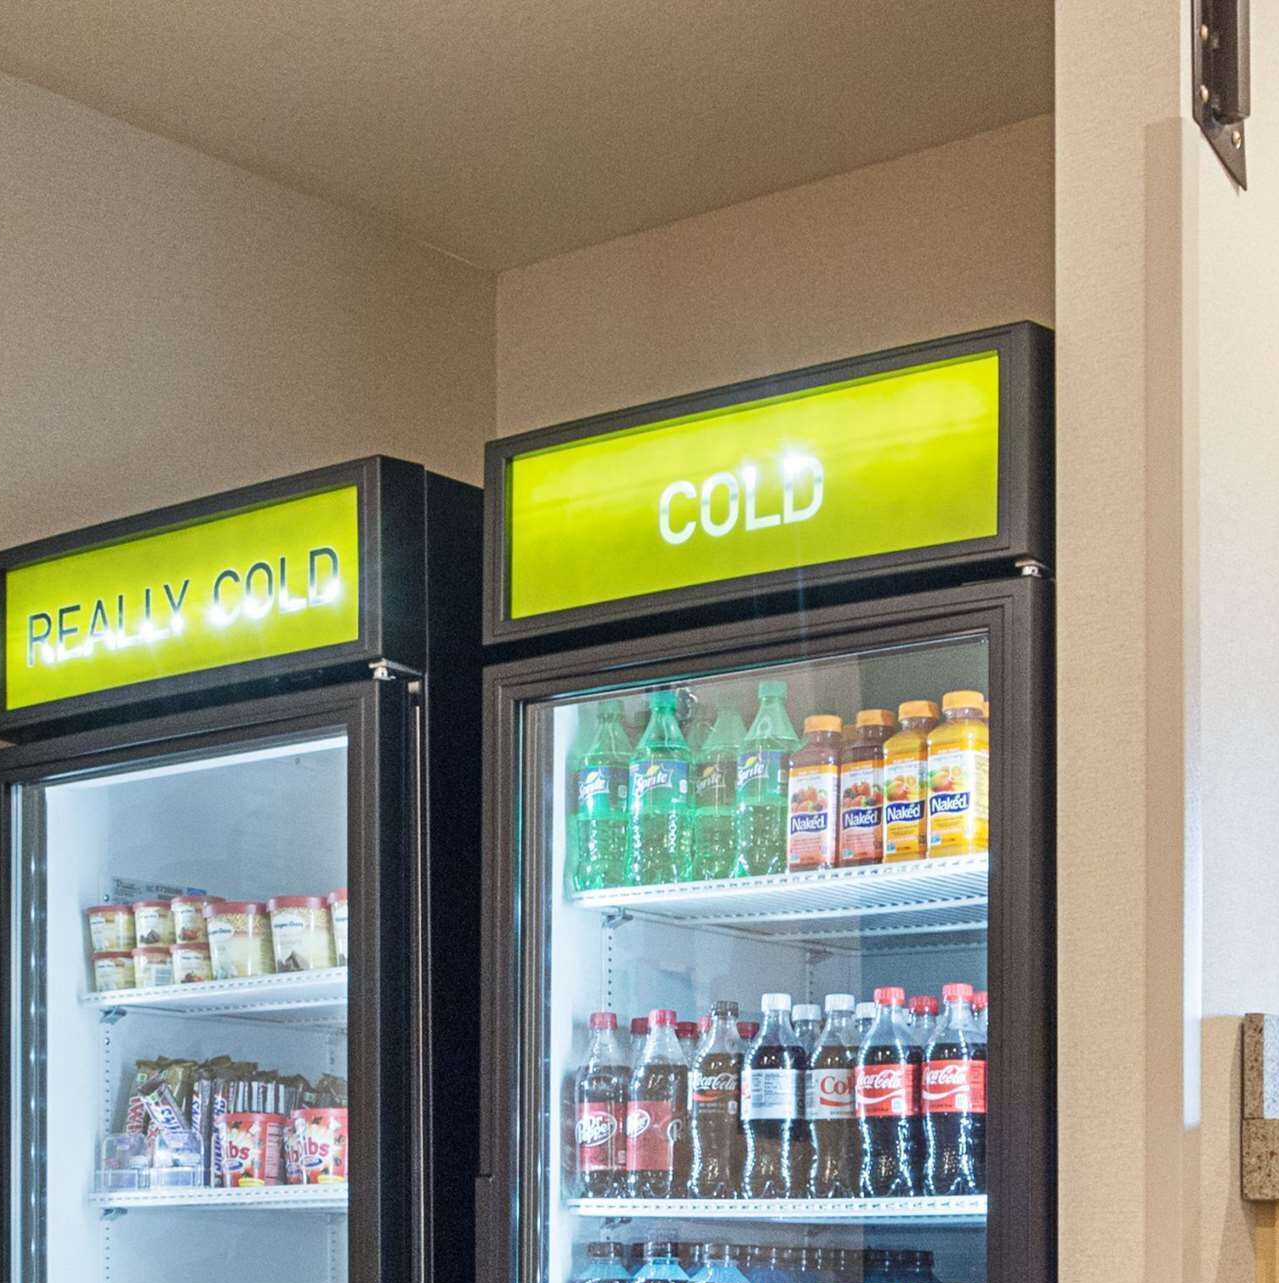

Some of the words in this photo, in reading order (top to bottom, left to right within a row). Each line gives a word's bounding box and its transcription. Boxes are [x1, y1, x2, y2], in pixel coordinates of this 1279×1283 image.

[659, 451, 825, 545] COLD
[26, 579, 190, 666] REALLY
[207, 547, 341, 627] COLD
